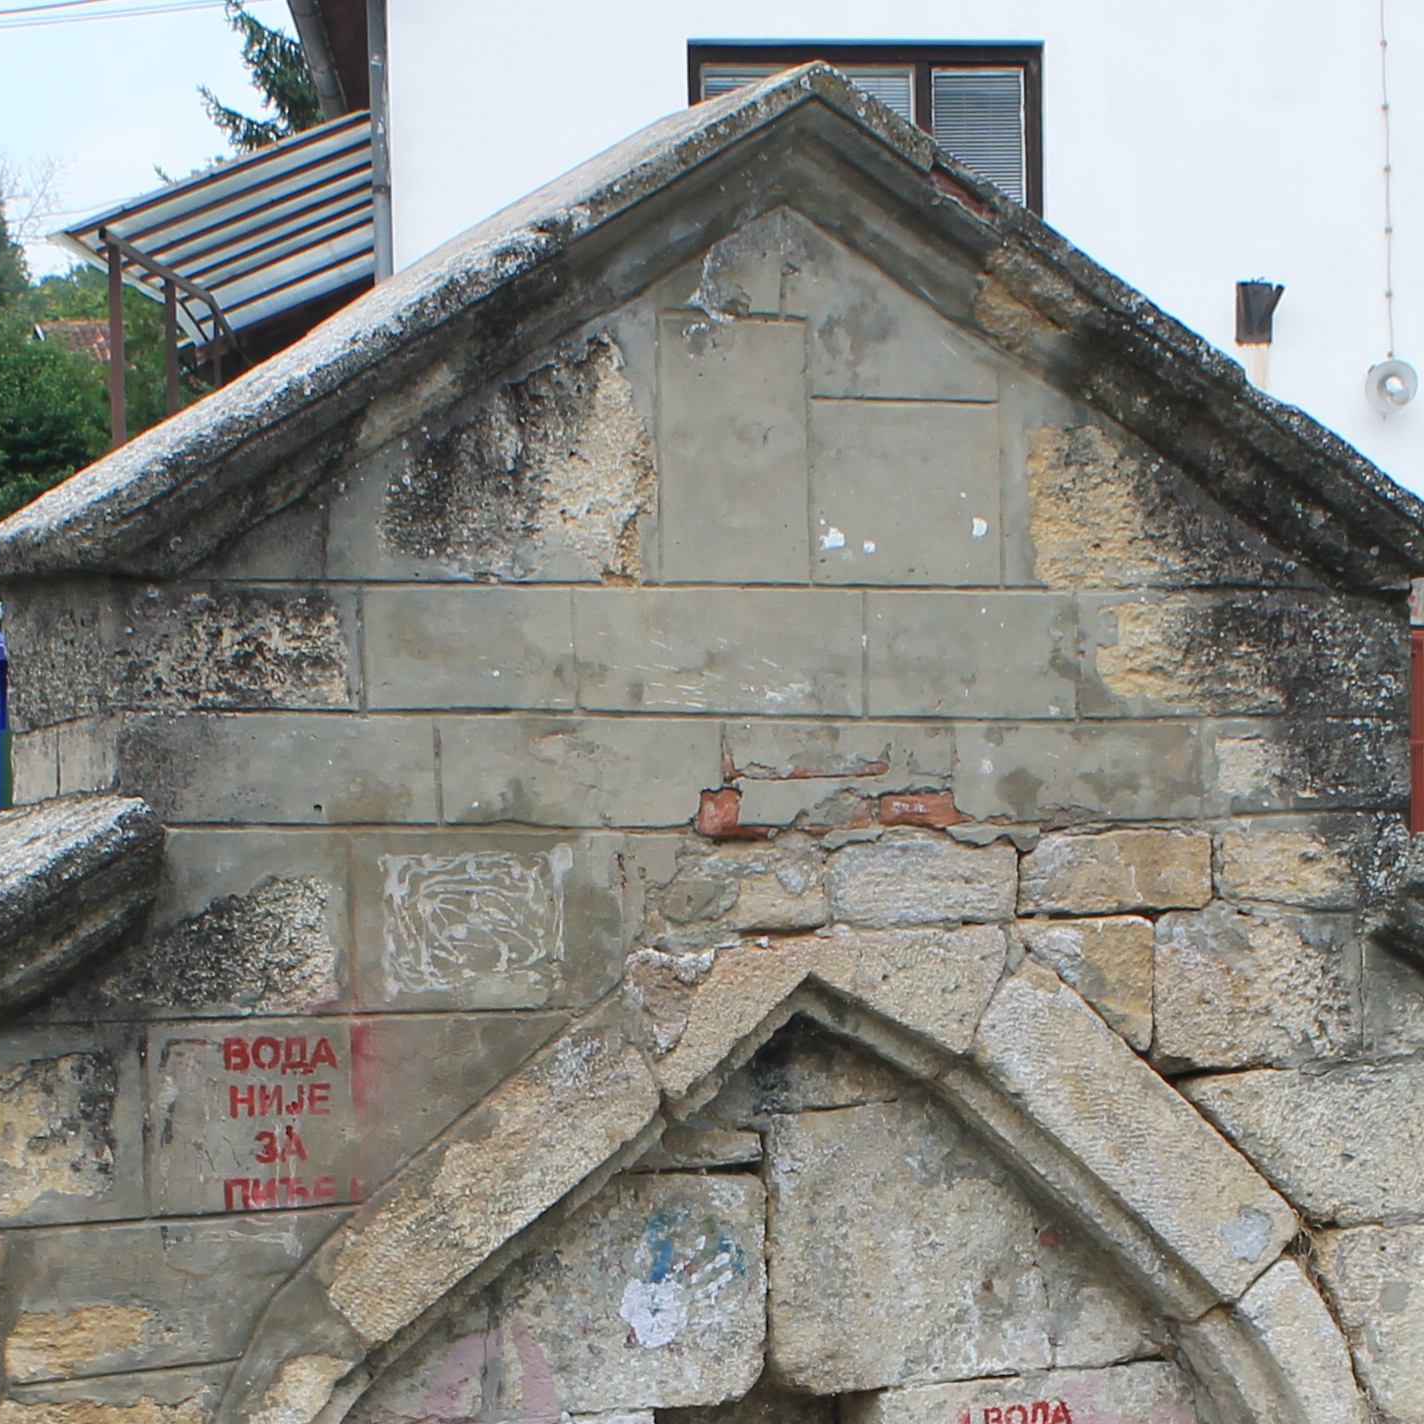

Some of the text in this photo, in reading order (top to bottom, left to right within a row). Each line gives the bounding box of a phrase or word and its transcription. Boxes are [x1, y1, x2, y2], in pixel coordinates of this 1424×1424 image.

[223, 1036, 338, 1075] ВОДА
[228, 1083, 332, 1119] НИЈЕ
[255, 1128, 308, 1164] ЗА
[224, 1175, 336, 1210] ПИЋЕ
